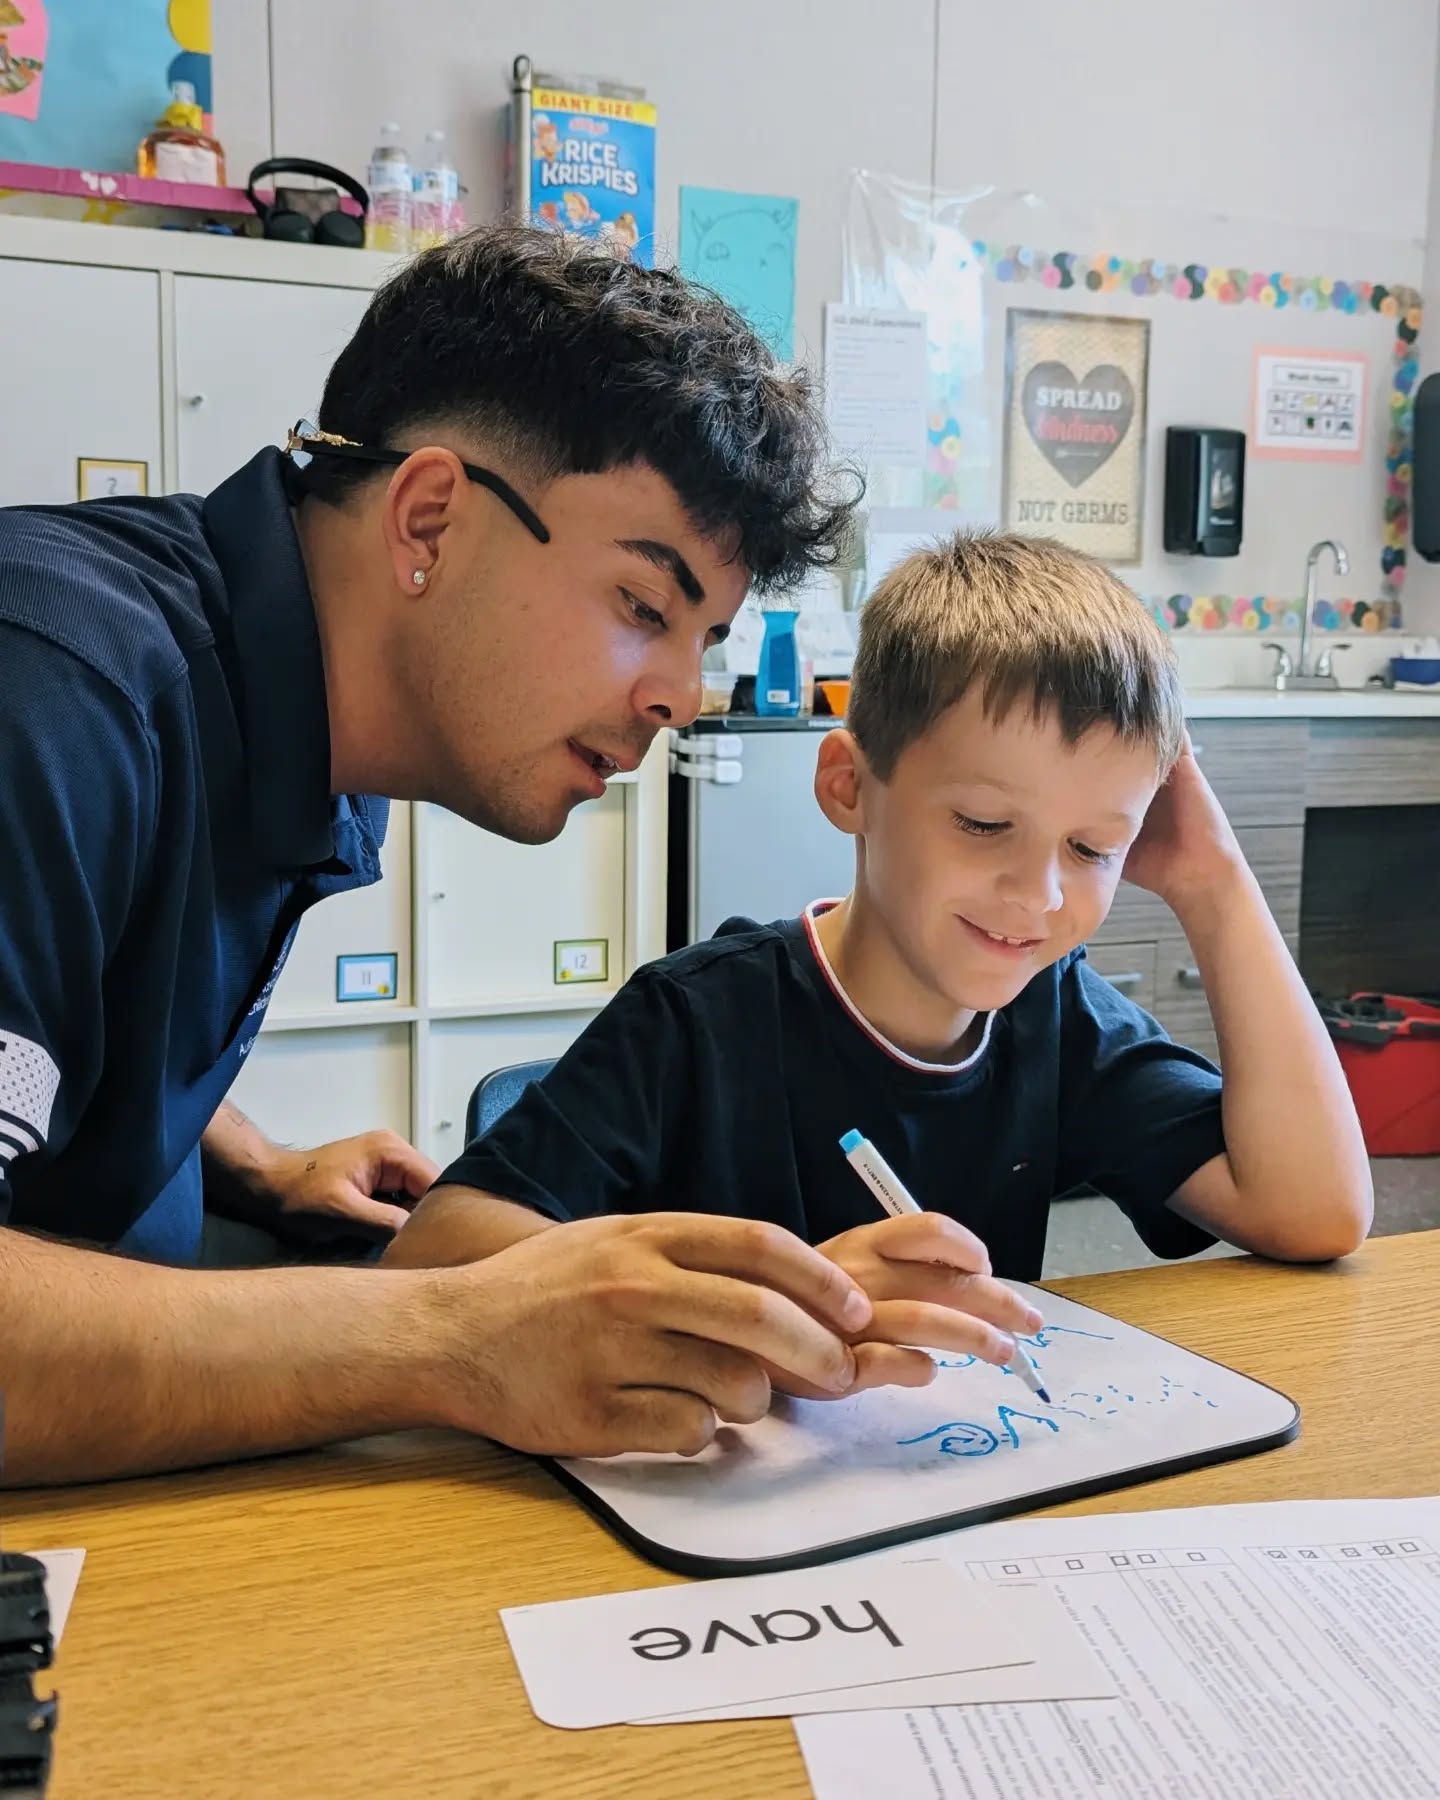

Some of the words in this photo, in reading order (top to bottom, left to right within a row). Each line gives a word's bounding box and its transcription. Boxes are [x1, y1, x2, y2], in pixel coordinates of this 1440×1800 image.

[540, 93, 591, 110] GIANT
[599, 101, 634, 117] SIZE
[565, 140, 617, 167] RICE
[542, 162, 639, 196] KRISPIES
[1036, 386, 1122, 411] SPREAD
[107, 476, 118, 496] 2
[1017, 500, 1059, 523] NOT
[1062, 502, 1129, 525] GERMS
[575, 953, 588, 969] 12
[628, 1600, 904, 1661] have
